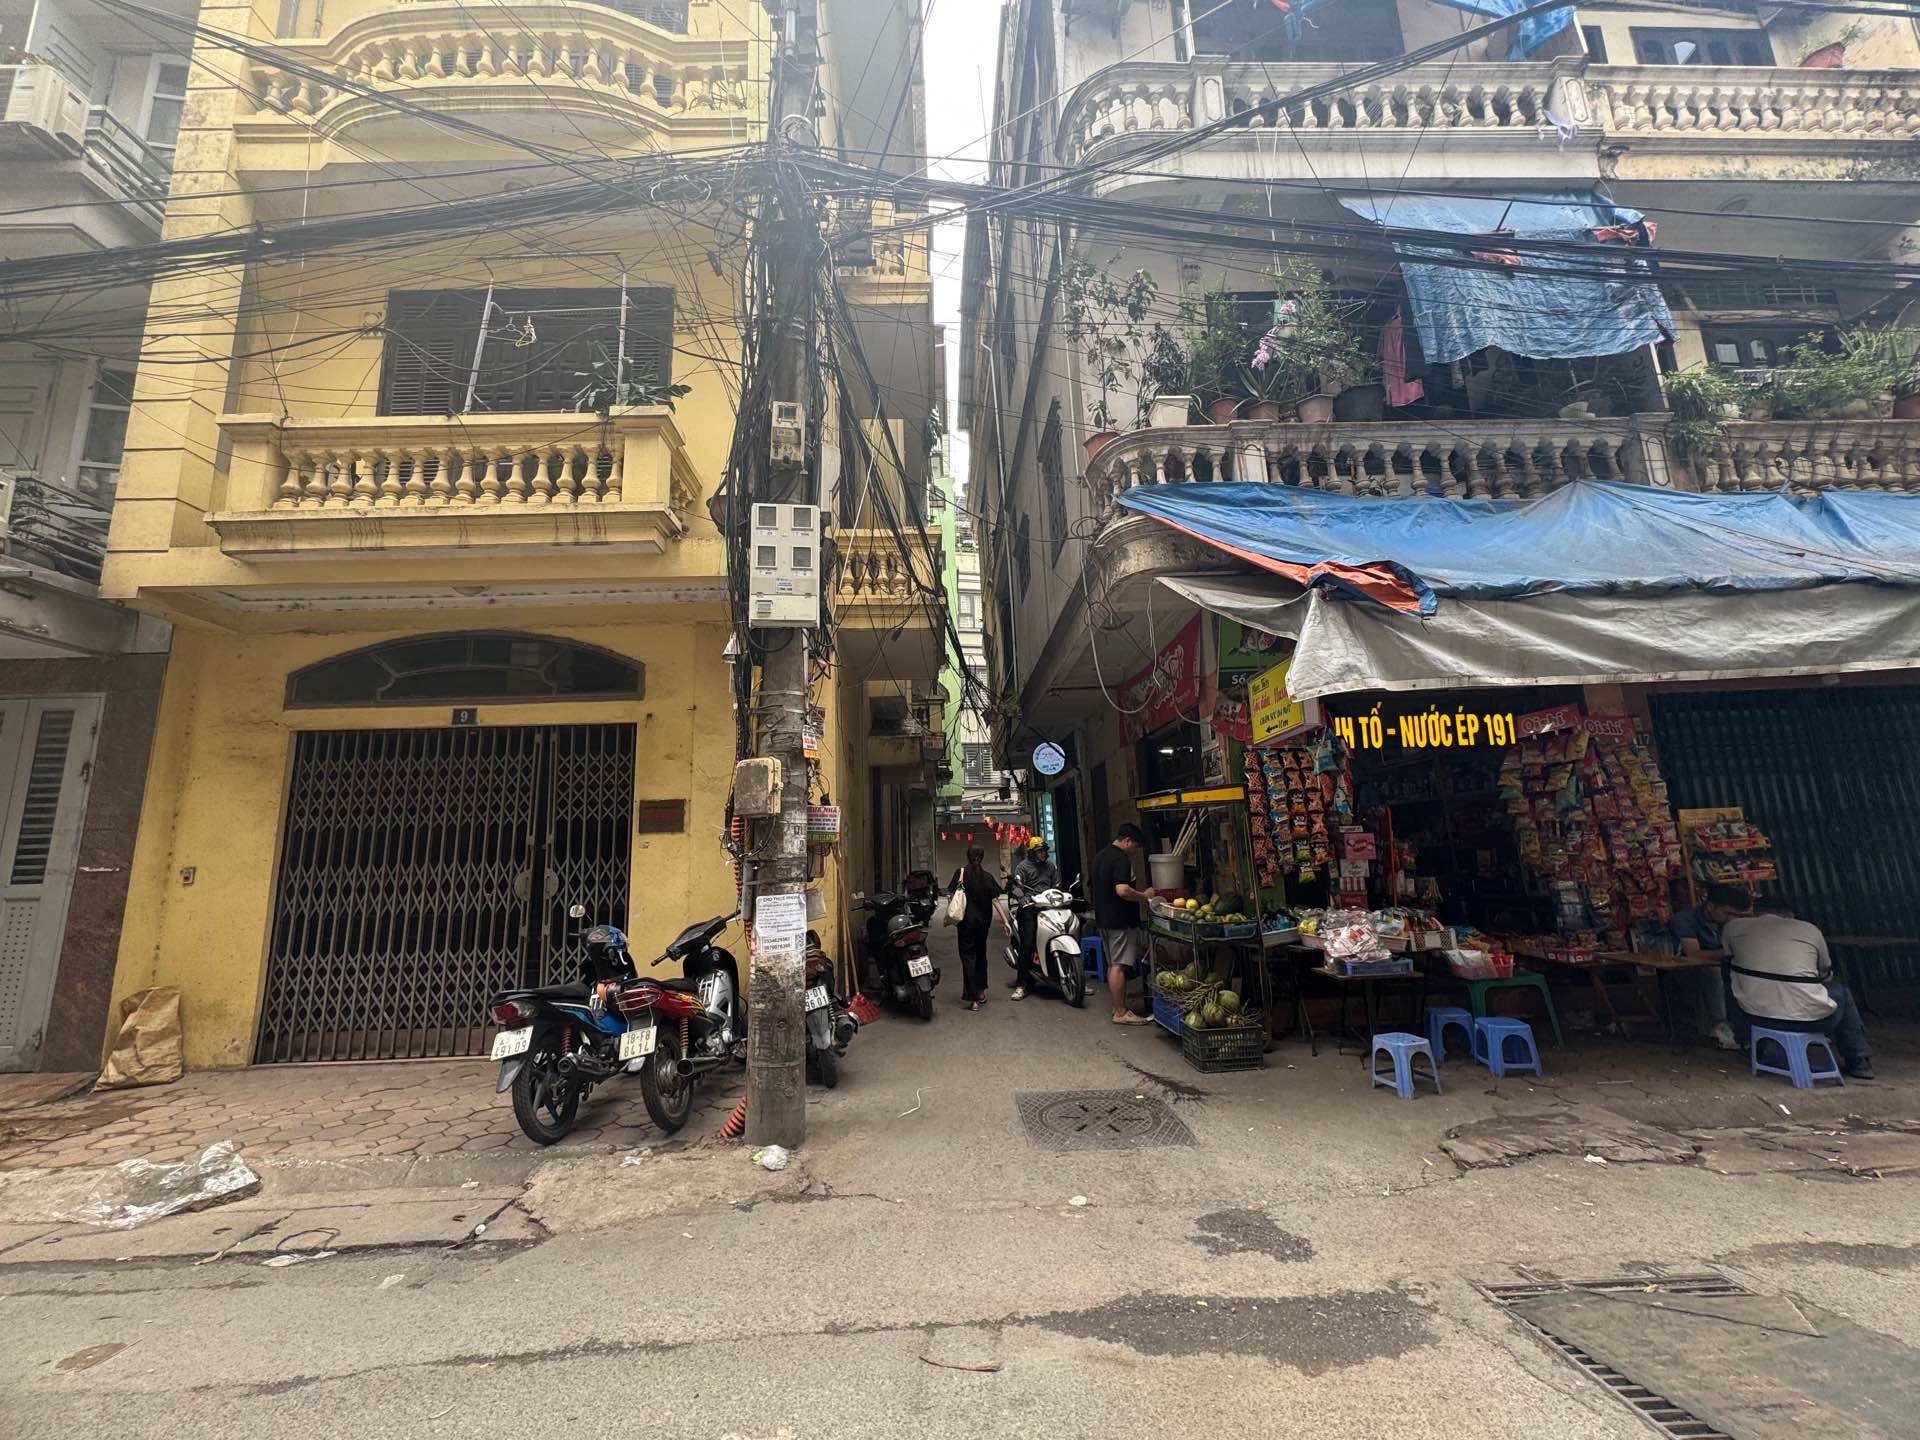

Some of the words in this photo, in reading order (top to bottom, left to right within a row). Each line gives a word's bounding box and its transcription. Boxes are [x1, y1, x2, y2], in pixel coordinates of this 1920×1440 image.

[460, 710, 468, 722] 9
[1358, 701, 1383, 749] TỐ
[1400, 704, 1453, 748] NƯỚC
[1455, 705, 1480, 746] ÉP
[1484, 712, 1516, 746] 191
[1583, 718, 1624, 736] Oishi
